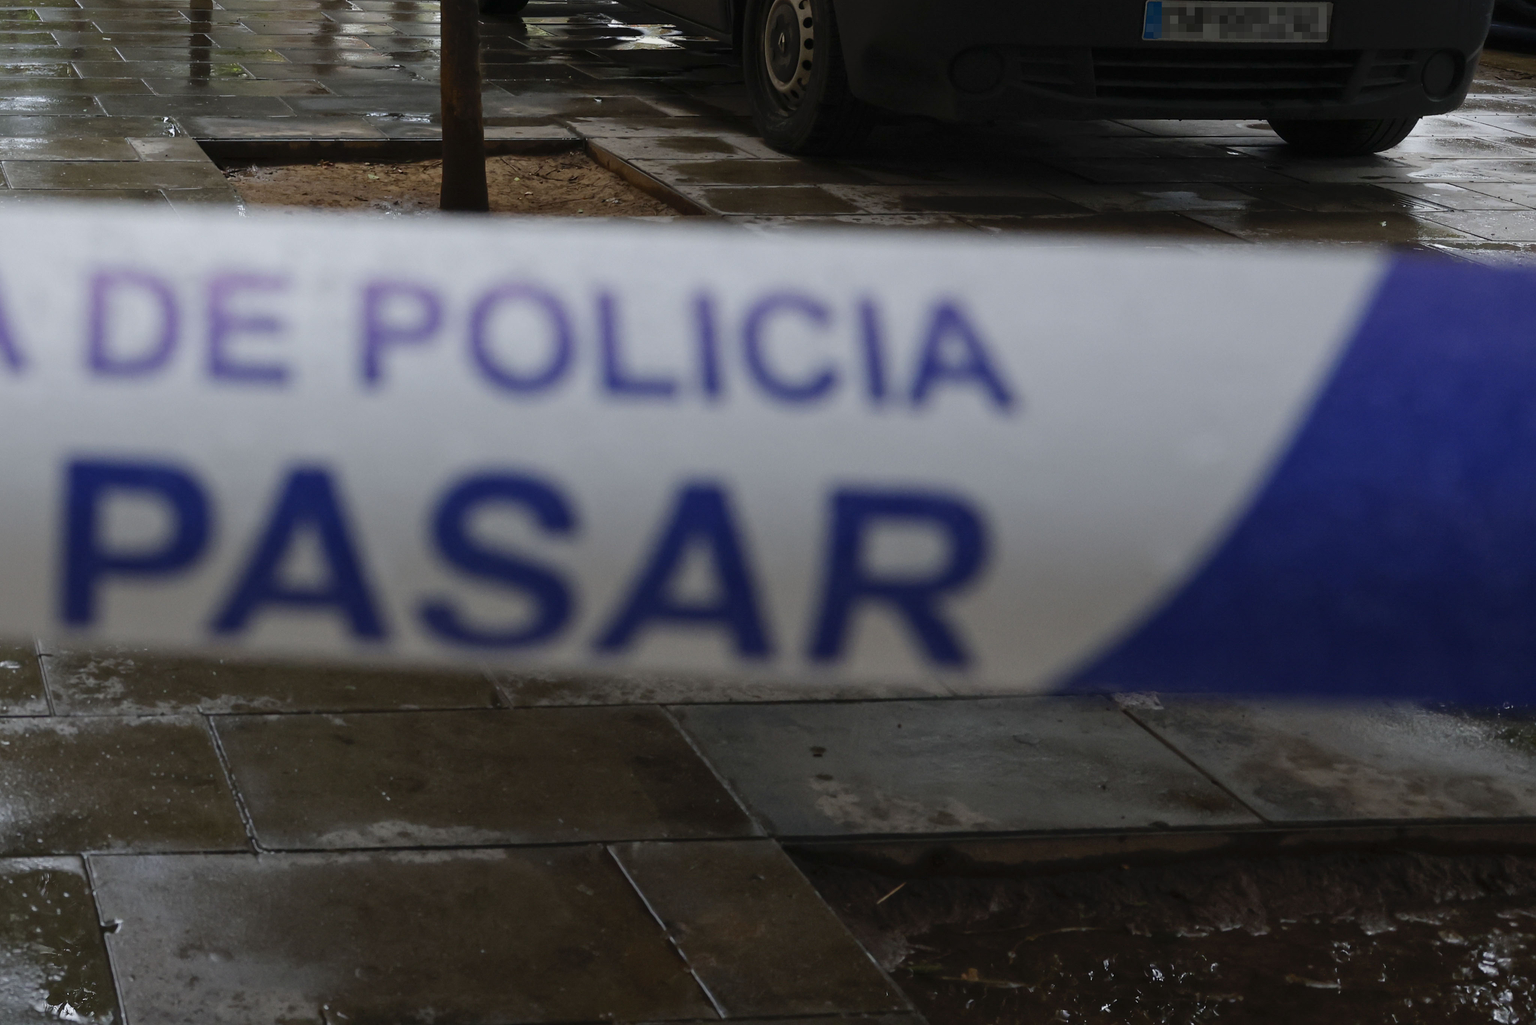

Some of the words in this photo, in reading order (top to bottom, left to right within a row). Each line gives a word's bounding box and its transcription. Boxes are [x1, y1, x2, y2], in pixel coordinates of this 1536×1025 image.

[81, 270, 301, 387] DE
[352, 274, 1020, 417] POLICIA
[54, 454, 998, 672] PASAR
